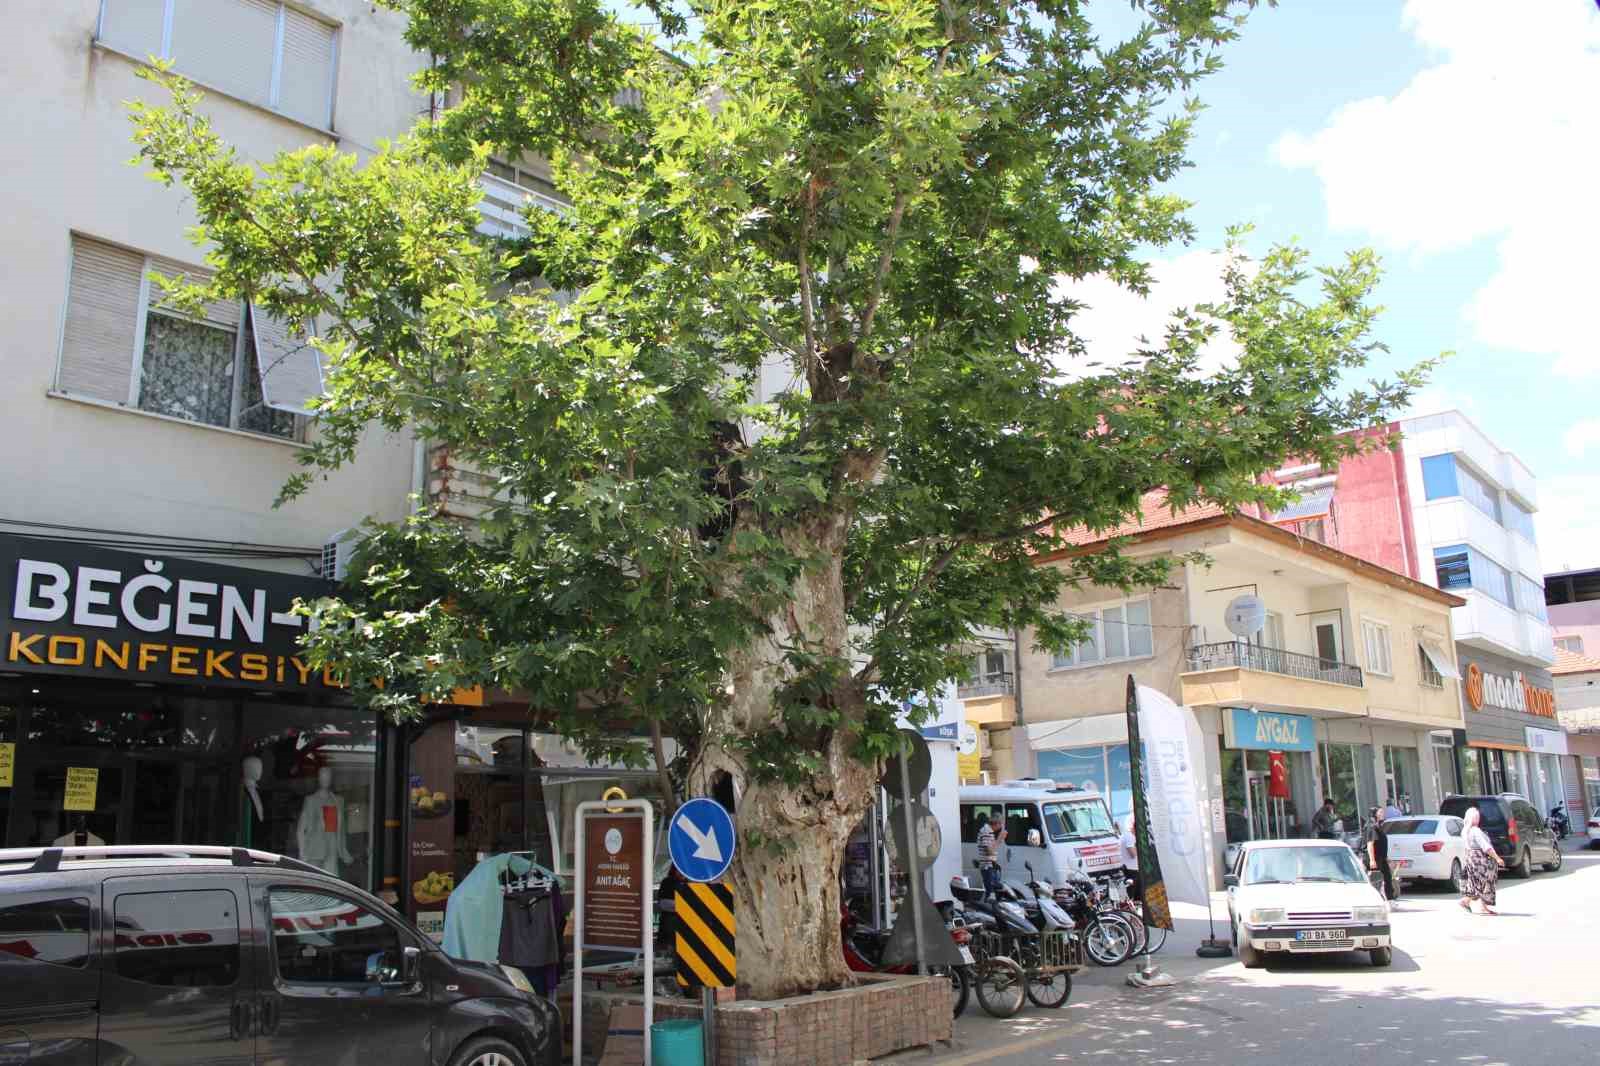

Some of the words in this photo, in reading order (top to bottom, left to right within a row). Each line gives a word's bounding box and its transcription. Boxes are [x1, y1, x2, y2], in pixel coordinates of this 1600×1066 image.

[1255, 716, 1299, 744] AYGAZ
[596, 875, 612, 887] ANIT
[611, 874, 632, 889] AĞAÇ
[1302, 931, 1312, 940] 20
[1314, 930, 1326, 940] BA
[1328, 930, 1345, 940] 960
